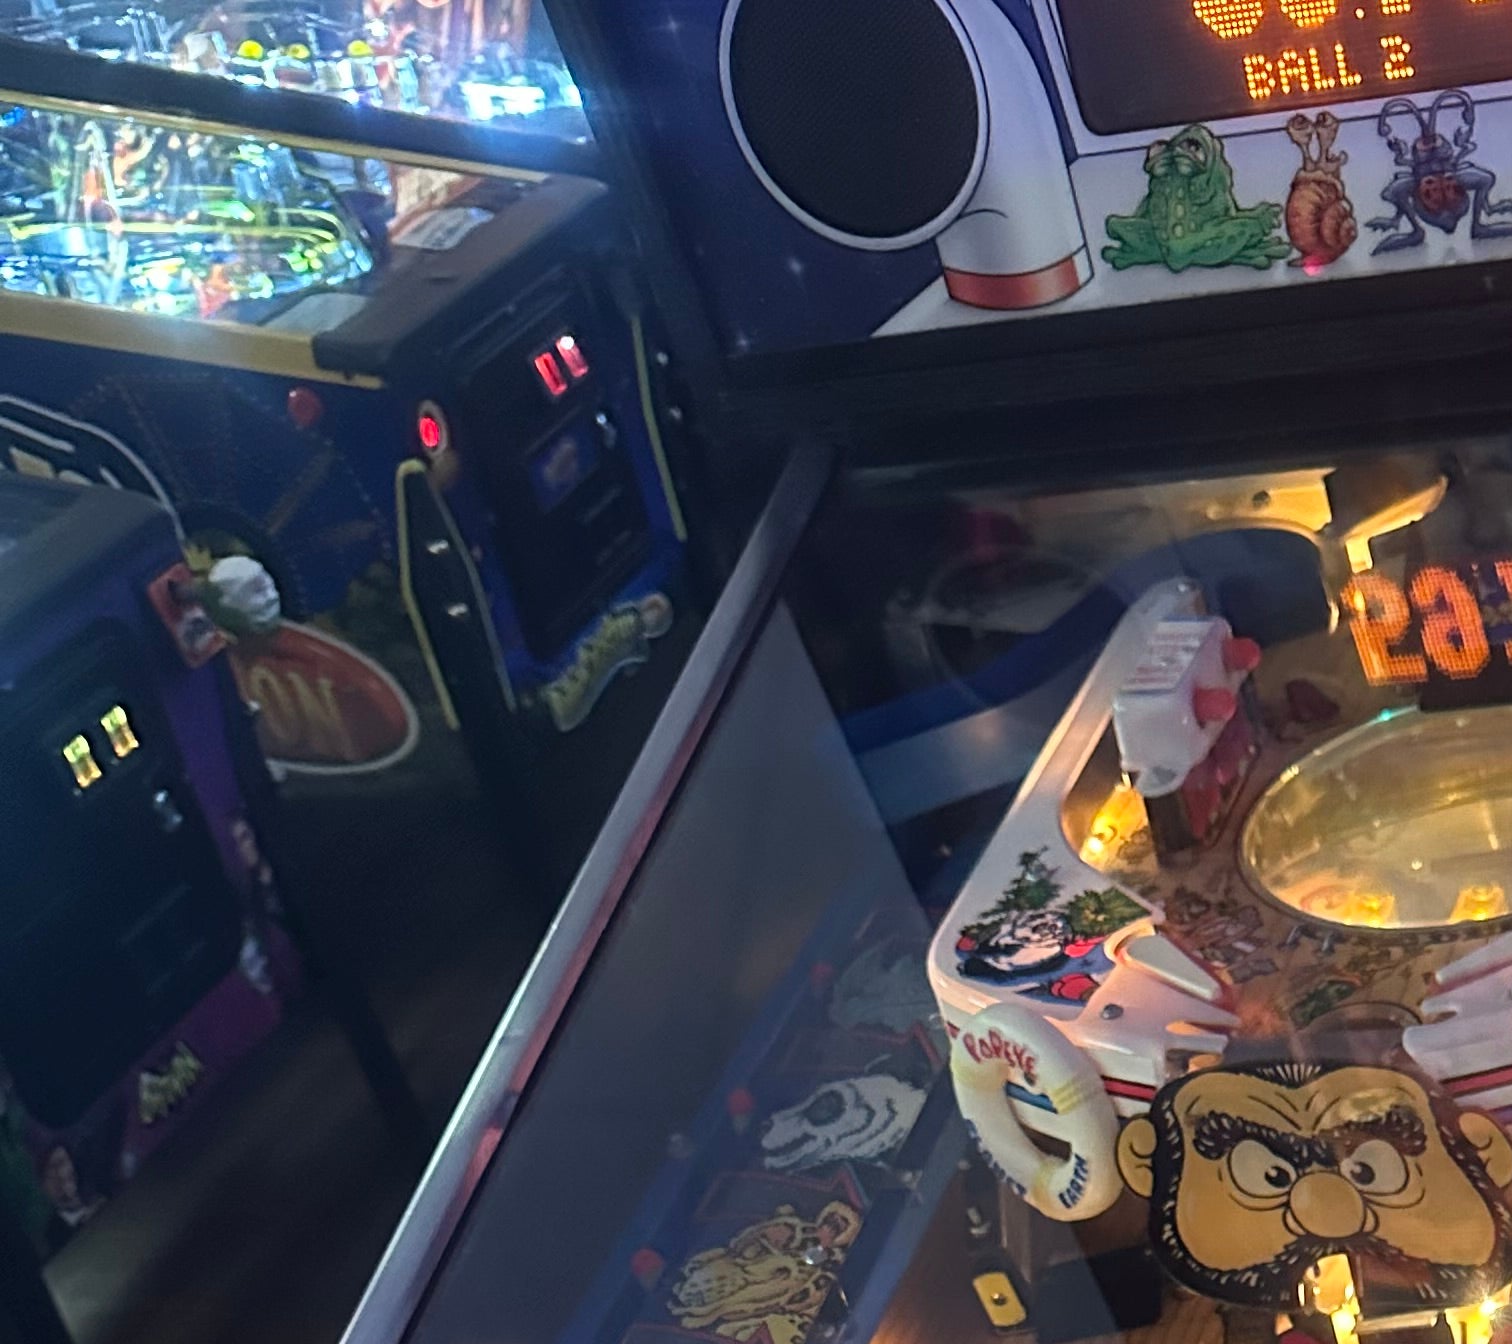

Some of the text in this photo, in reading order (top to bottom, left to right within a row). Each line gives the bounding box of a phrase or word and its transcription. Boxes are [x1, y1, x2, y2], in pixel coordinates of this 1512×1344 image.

[1243, 43, 1362, 100] BALL
[963, 1027, 1037, 1073] POPEYE
[1059, 1153, 1088, 1209] EARTH
